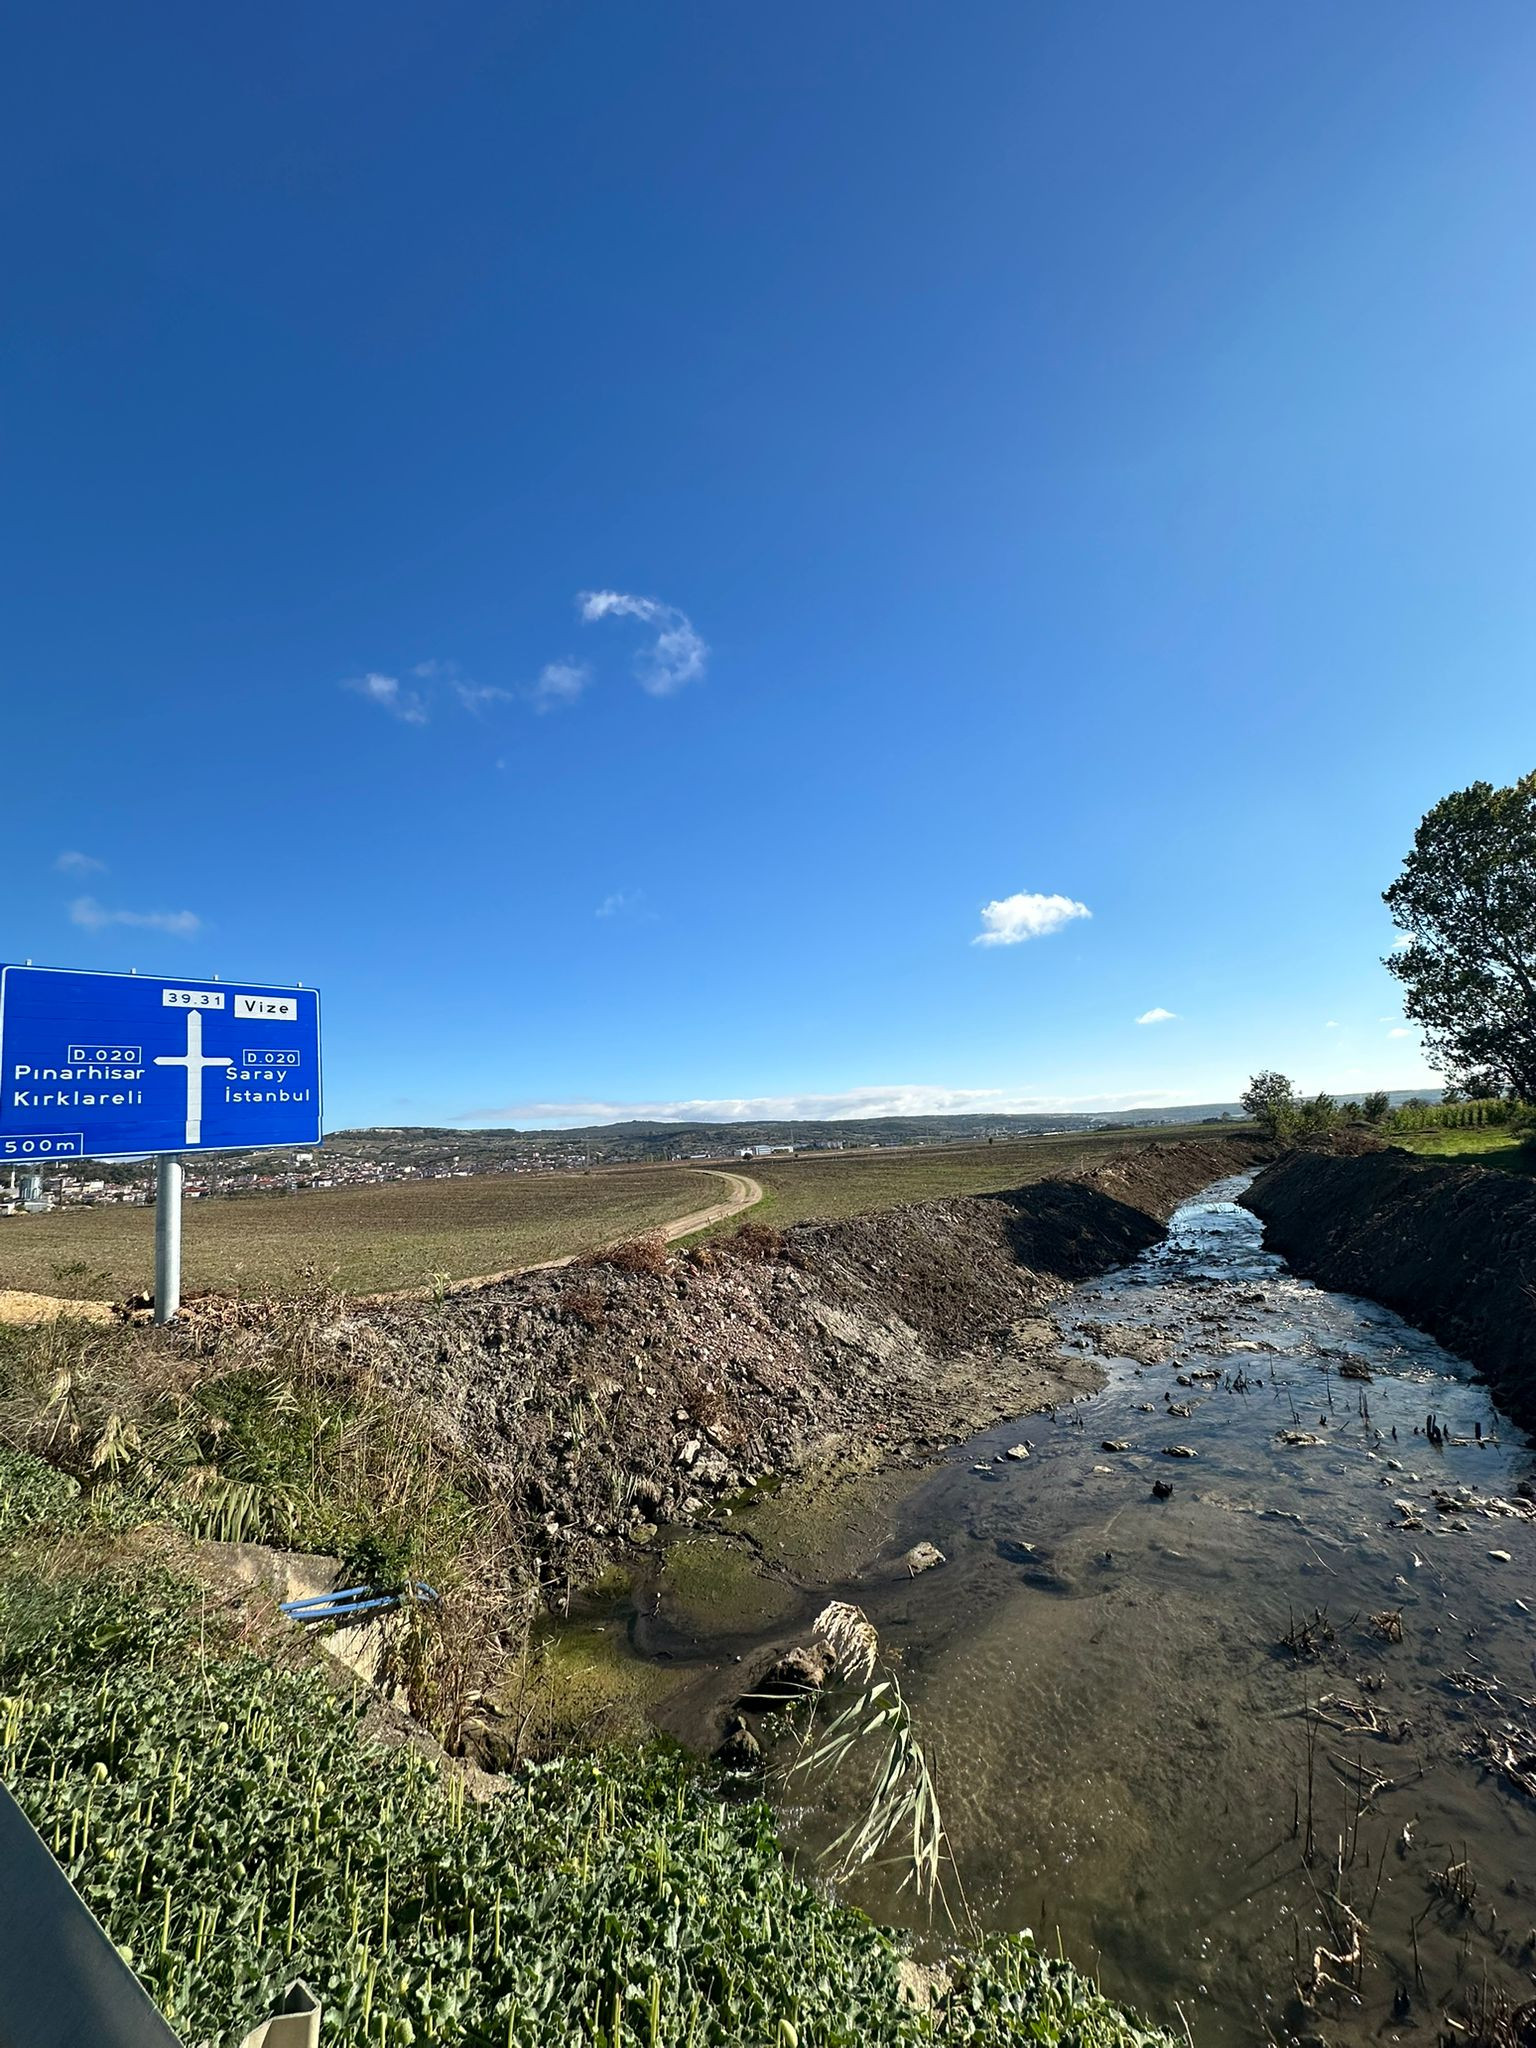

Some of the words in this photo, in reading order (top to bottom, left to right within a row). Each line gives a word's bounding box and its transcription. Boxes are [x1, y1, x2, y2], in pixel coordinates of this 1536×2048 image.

[168, 993, 220, 1005] 39.31
[245, 1000, 289, 1014] Vize
[73, 1049, 136, 1061] D.020
[247, 1053, 296, 1064] D.020
[15, 1065, 146, 1080] Pınarhisar
[226, 1067, 287, 1083] Saray
[14, 1090, 142, 1106] Kırklareli
[225, 1086, 310, 1102] İstanbul
[5, 1139, 75, 1153] 500m
